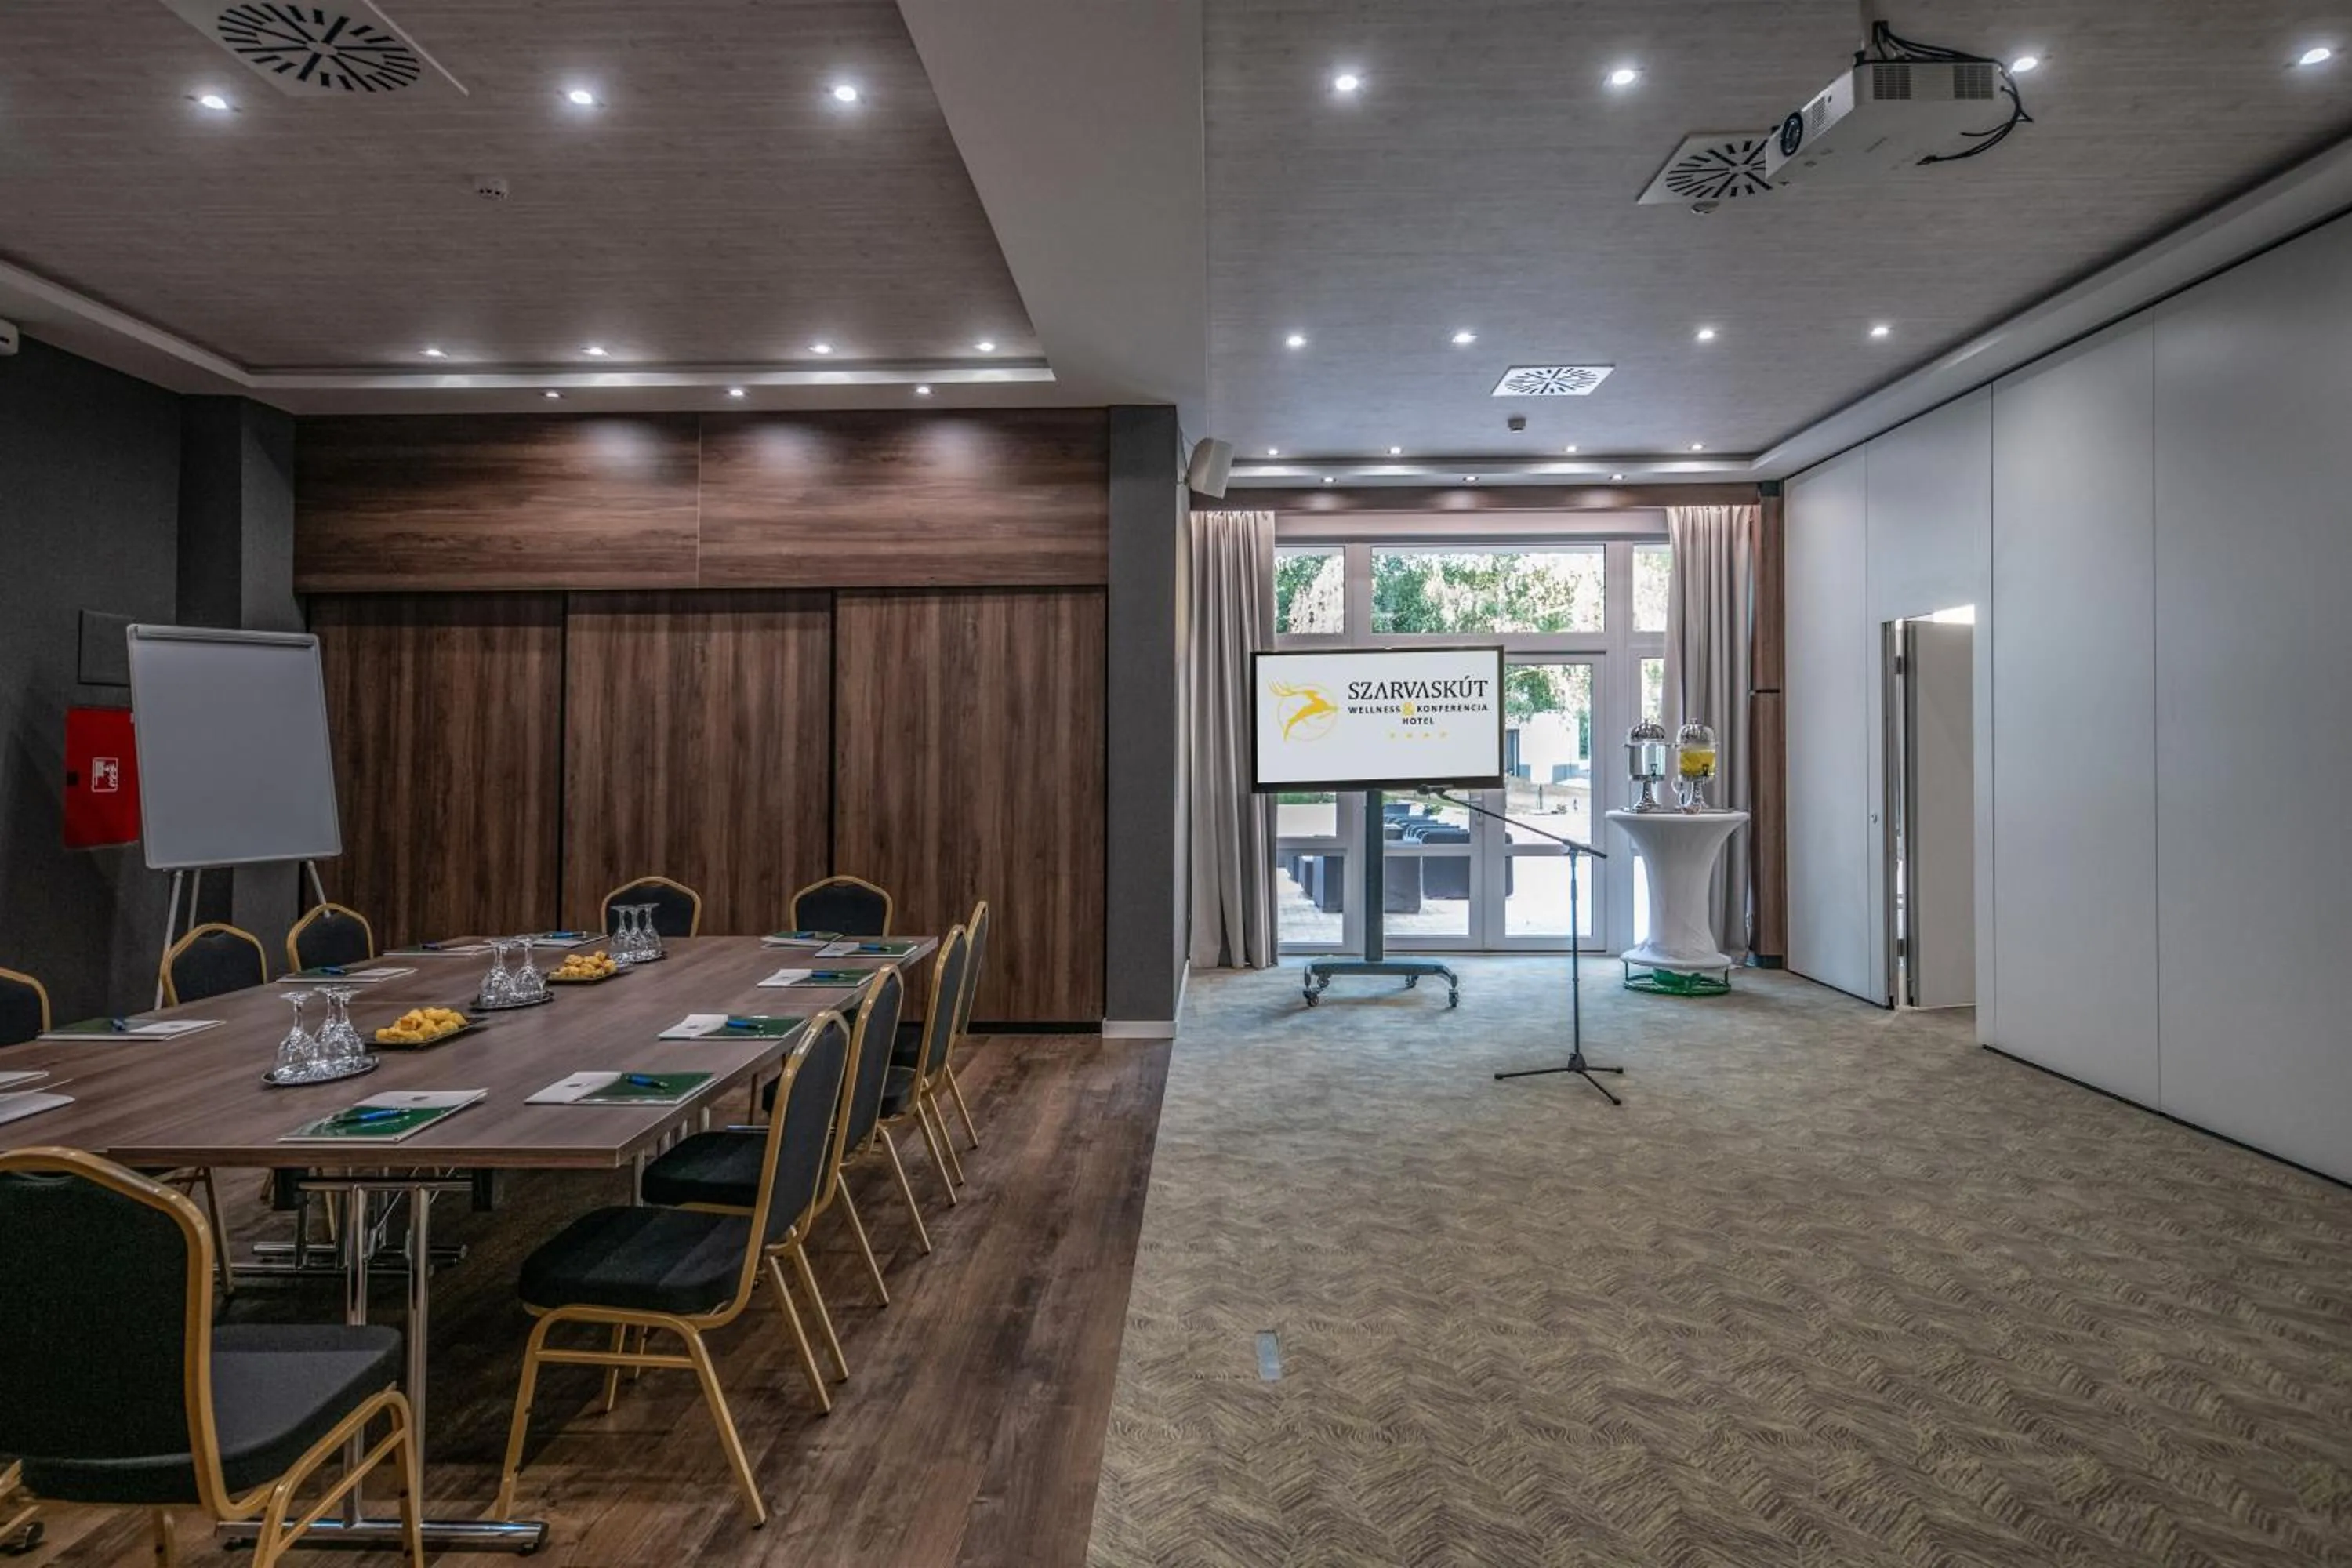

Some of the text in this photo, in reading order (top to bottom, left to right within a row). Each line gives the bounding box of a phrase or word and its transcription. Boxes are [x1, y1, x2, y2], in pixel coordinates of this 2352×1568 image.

[1348, 675, 1489, 700] SZARVASKÚT
[1348, 705, 1401, 714] WELLNESS
[1417, 703, 1489, 713] KONFERENCIA
[1402, 717, 1435, 725] HOTEL
